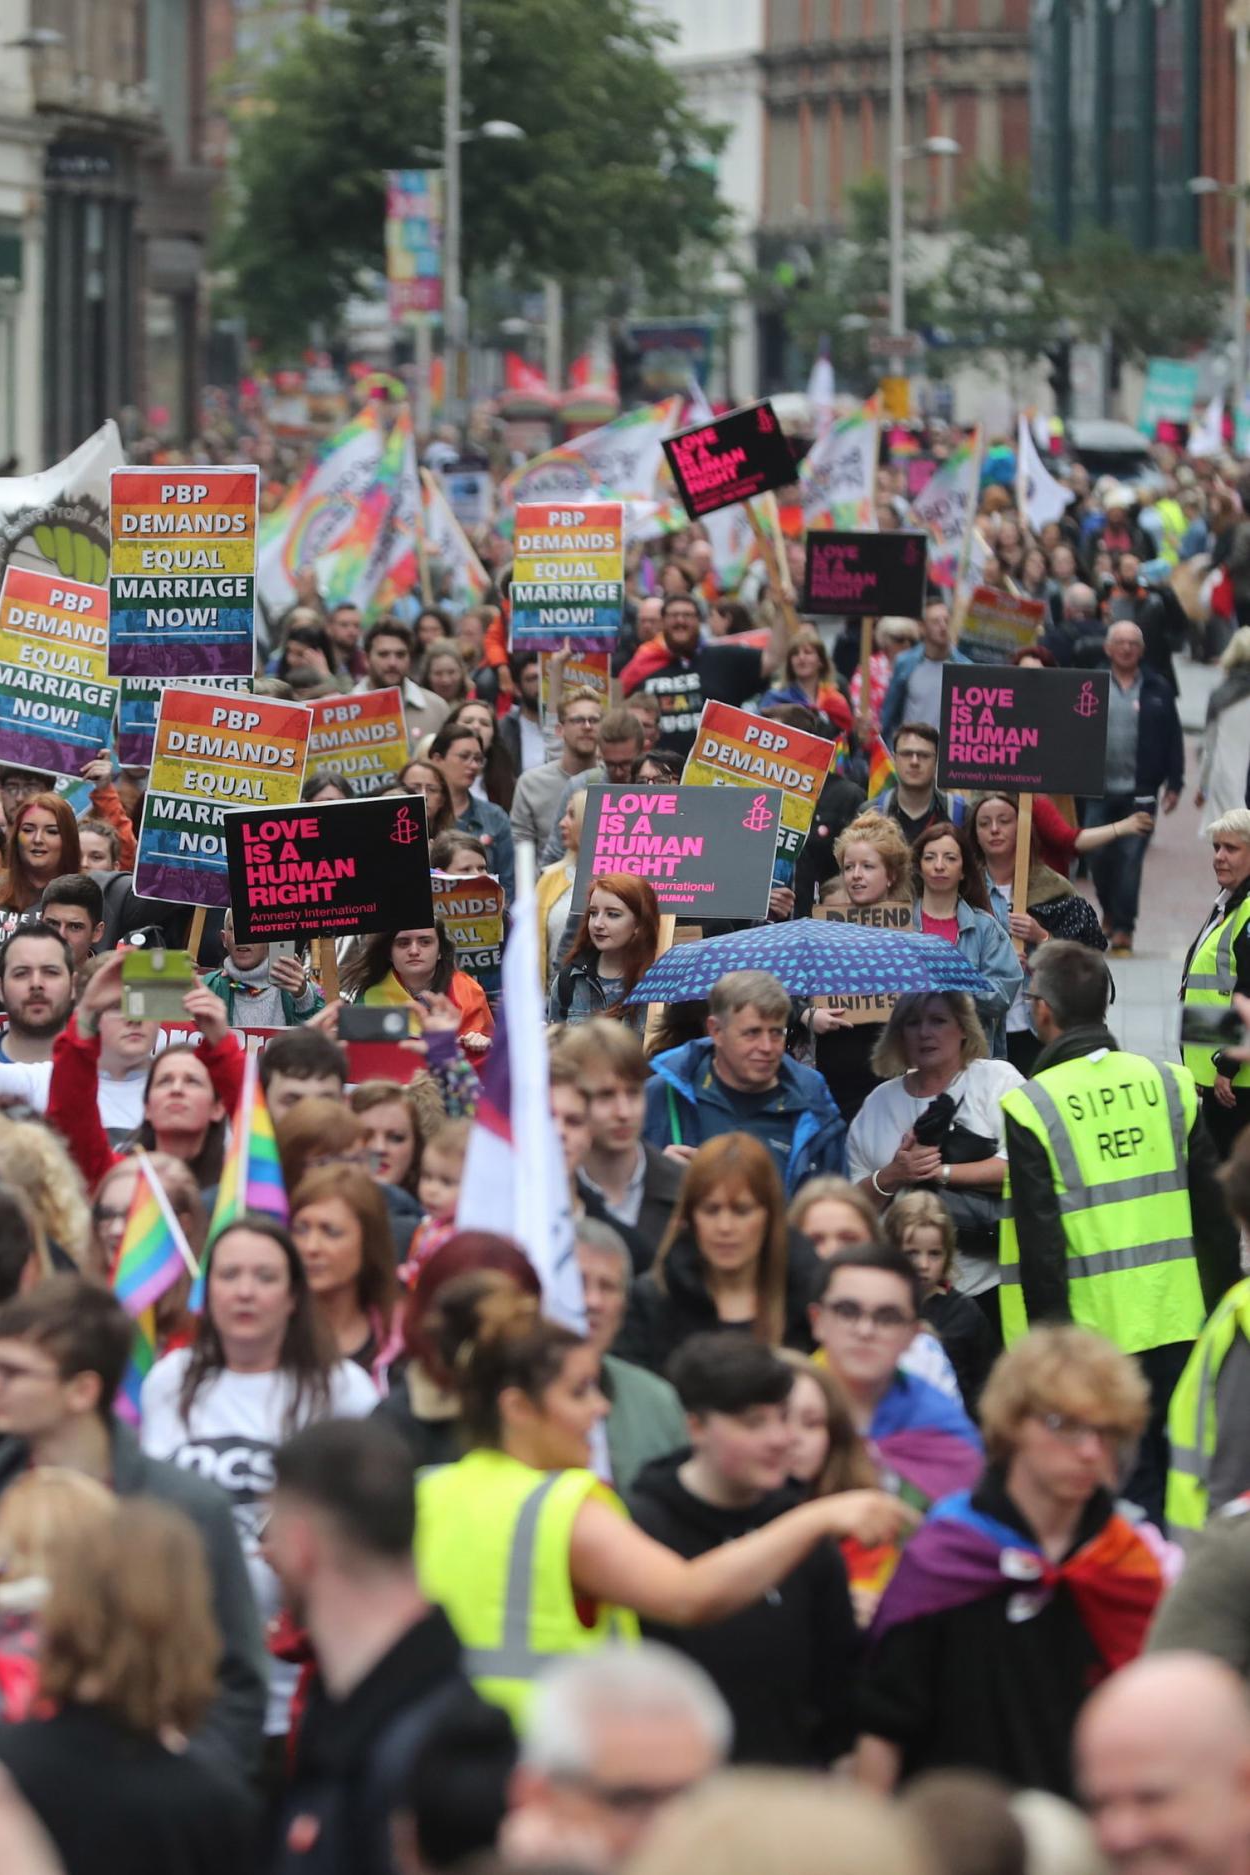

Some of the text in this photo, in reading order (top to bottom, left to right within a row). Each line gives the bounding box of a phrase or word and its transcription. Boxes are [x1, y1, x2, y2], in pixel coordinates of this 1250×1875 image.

[161, 484, 209, 504] PBP
[121, 513, 247, 533] DEMANDS
[548, 511, 586, 527] PBP
[518, 533, 616, 551] DEMANDS
[812, 544, 859, 560] LOVE
[141, 549, 226, 573] EQUAL
[533, 563, 599, 580] EQUAL
[116, 578, 248, 599] MARRIAGE
[516, 584, 619, 602] MARRIAGE
[49, 589, 94, 614] PBP
[7, 607, 108, 646] DEMAND
[146, 608, 219, 629] NOW!
[539, 608, 595, 625] NOW!
[19, 645, 94, 678] EQUAL
[951, 686, 1015, 708] LOVE
[12, 697, 80, 729] NOW!
[211, 707, 261, 732] PBP
[323, 704, 362, 724] PBP
[950, 706, 996, 726] IS A
[309, 721, 398, 751] EMANDS
[744, 725, 790, 753] PBP
[949, 725, 1039, 748] HUMAN
[167, 731, 296, 769] DEMANDS
[948, 743, 1022, 766] RIGHT
[702, 738, 816, 794] DEMANDS
[947, 769, 1042, 784] Amnesty International
[184, 770, 268, 801] EQUAL
[152, 798, 224, 826] MARR
[601, 793, 678, 815] LOVE
[242, 818, 320, 843] LOVE
[598, 815, 653, 835] IS A
[178, 832, 226, 857] NO
[244, 841, 300, 865] IS A
[595, 835, 704, 857] HUMAN
[246, 857, 356, 886] HUMAN
[592, 857, 682, 878] RIGHT
[248, 881, 337, 908] RIGHT
[431, 879, 458, 893] BP
[650, 880, 715, 893] nternational
[434, 897, 498, 915] ANDS
[658, 894, 695, 904] HUMAN
[250, 902, 378, 924] Amnesty International
[250, 917, 360, 934] PROTECT THE HUMAN
[1067, 1080, 1160, 1121] SIPTU
[1097, 1126, 1145, 1162] REP
